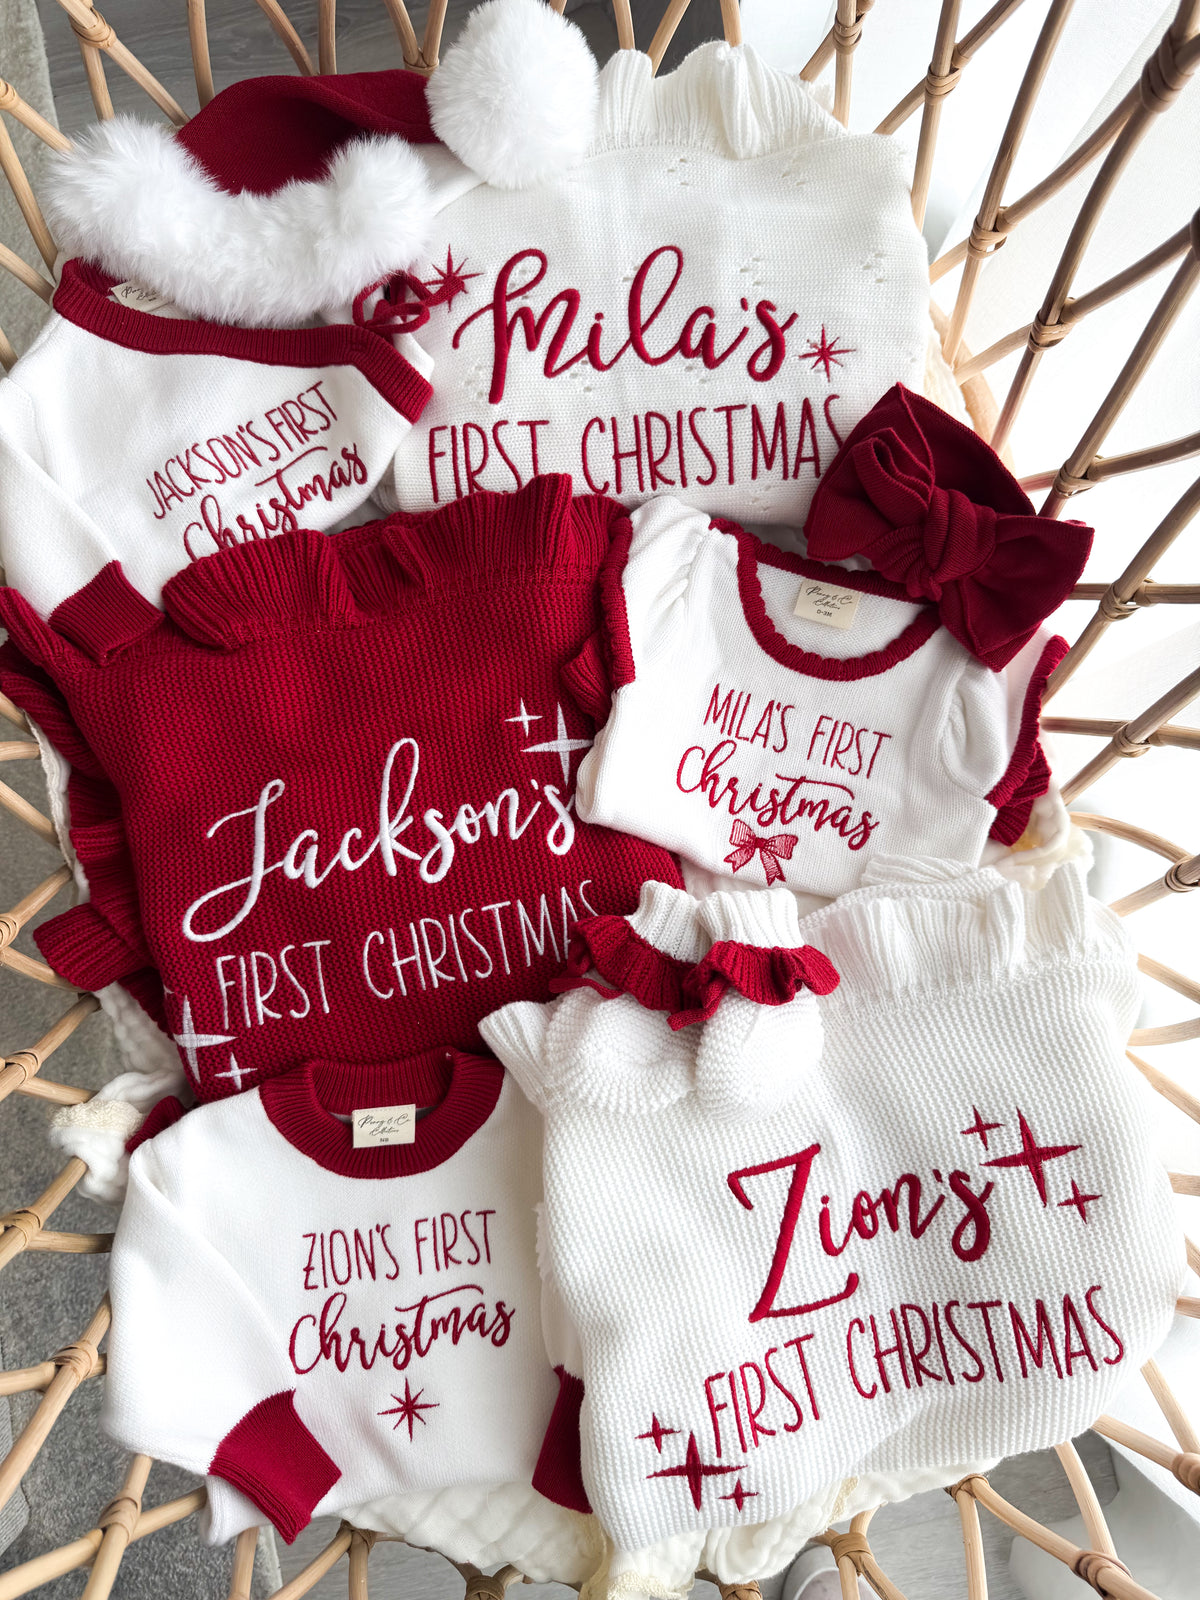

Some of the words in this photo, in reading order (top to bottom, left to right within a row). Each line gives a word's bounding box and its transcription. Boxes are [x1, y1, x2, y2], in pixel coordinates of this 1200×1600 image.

[452, 245, 798, 404] Mila's
[146, 420, 281, 520] JACKSON'S
[264, 380, 338, 452] FIRST
[428, 420, 550, 504] FIRST
[703, 683, 795, 753] MILA'S
[807, 715, 892, 779] FIRST
[183, 737, 577, 942] Jackson's
[676, 739, 880, 851] Christmas
[216, 940, 332, 1030] FIRST
[302, 1224, 400, 1290] ZION'S
[415, 1209, 496, 1275] FIRST
[727, 1142, 994, 1323] Zion's
[289, 1284, 516, 1375] Christmas
[705, 1333, 820, 1458] FIRST
[847, 1285, 1124, 1399] CHRISTMAS
